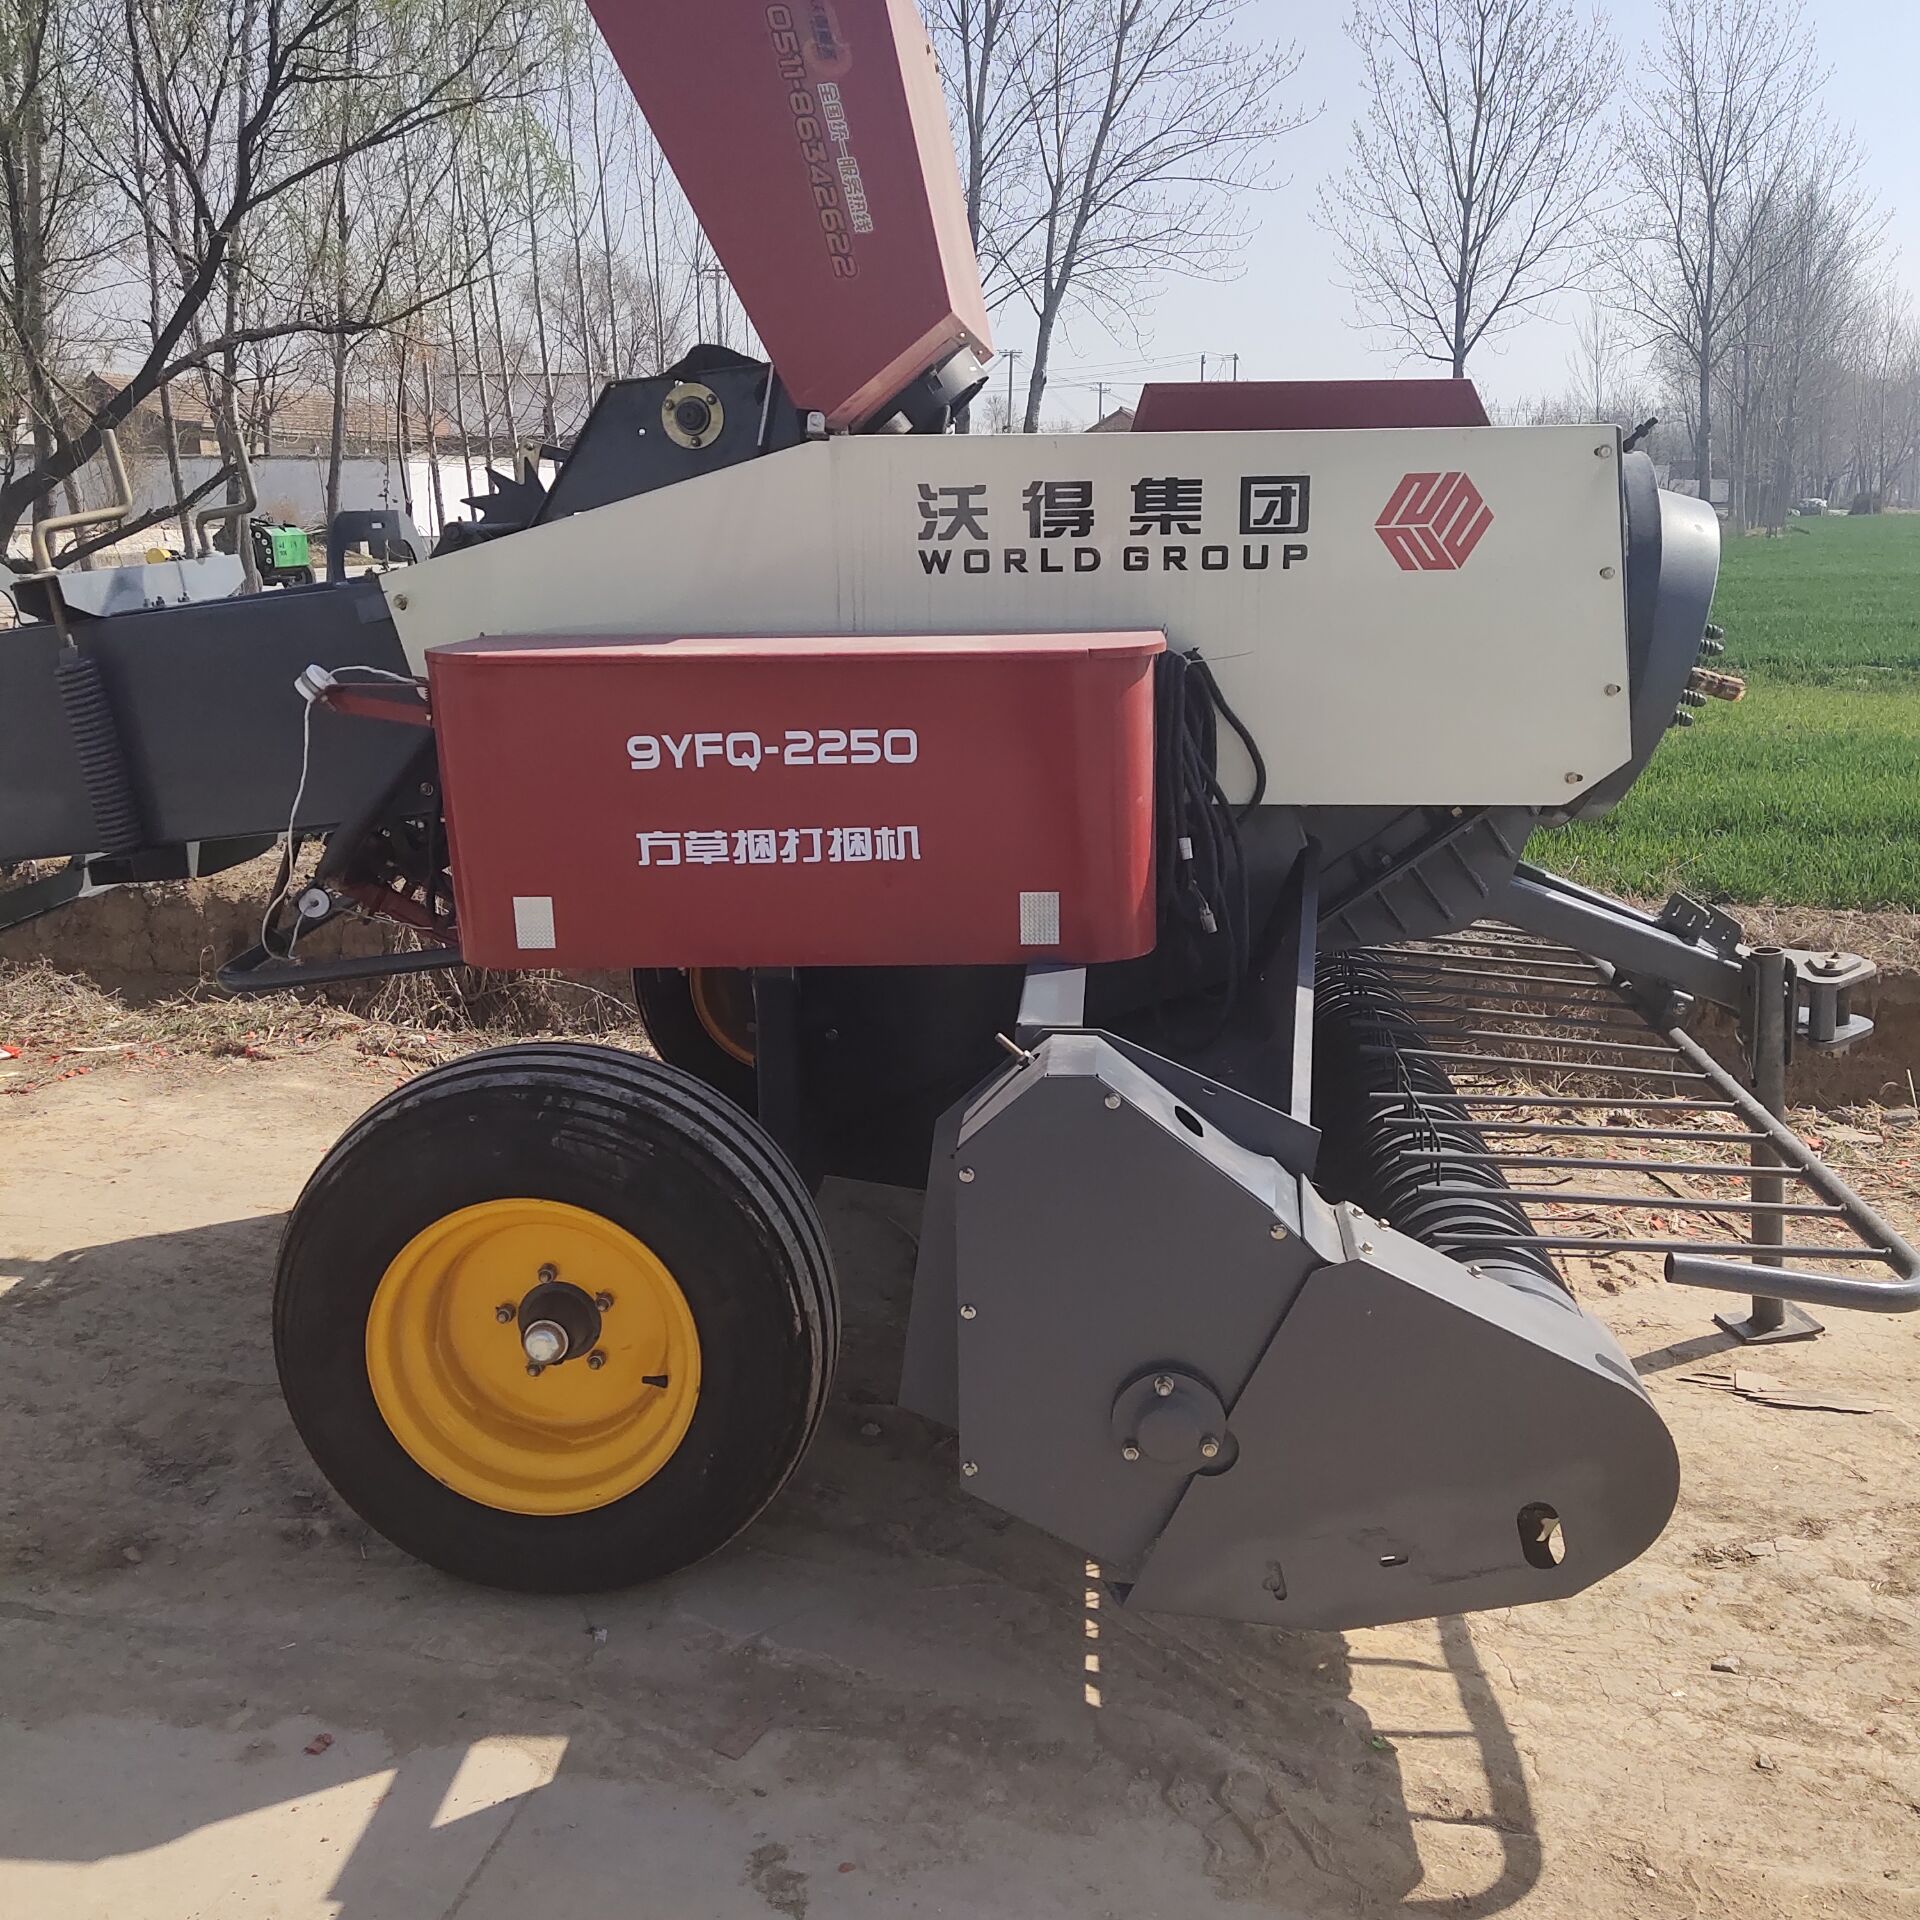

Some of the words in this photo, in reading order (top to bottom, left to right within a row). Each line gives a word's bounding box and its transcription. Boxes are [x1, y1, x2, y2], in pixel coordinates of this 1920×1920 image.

[765, 3, 859, 280] 0511-86342622
[817, 82, 873, 233] 全国统一服务热线
[917, 475, 1311, 541] 沃得集团
[917, 546, 1101, 575] WORLD
[1122, 543, 1309, 572] GROUP
[626, 728, 918, 772] 9YFQ-2250
[635, 825, 921, 867] 方草捆打捆机
